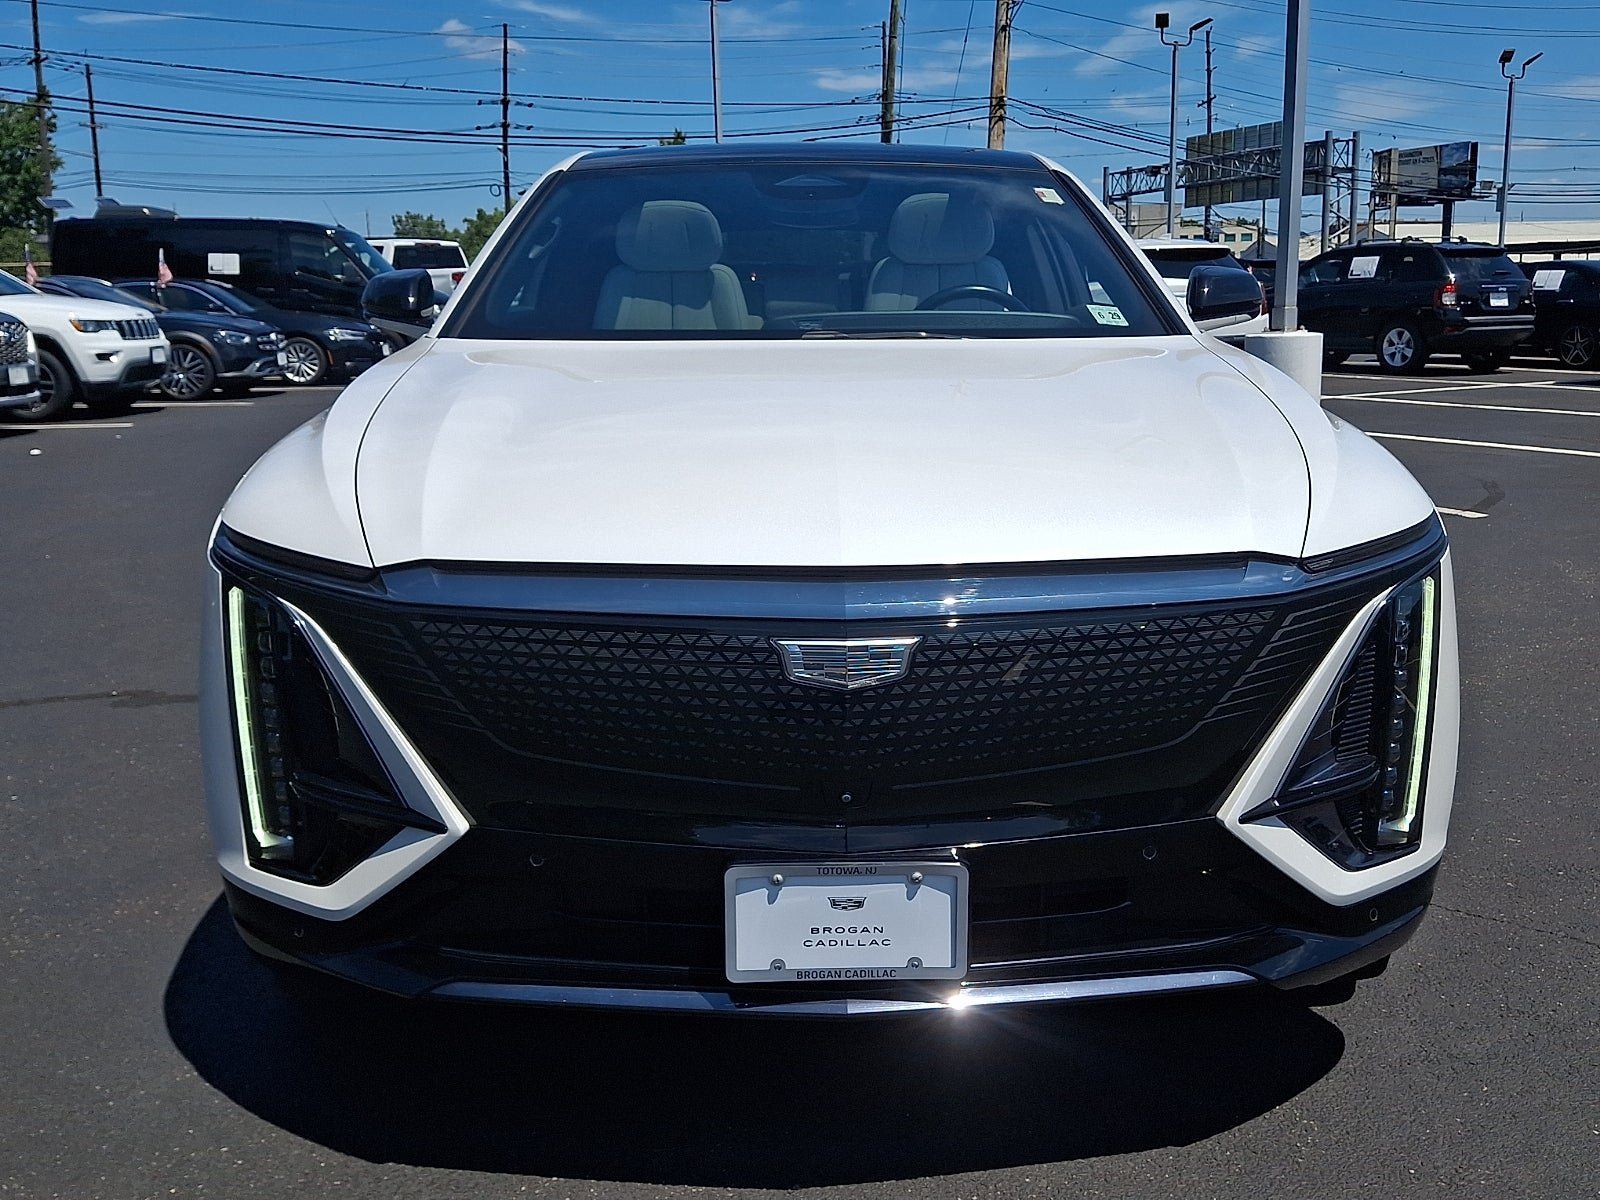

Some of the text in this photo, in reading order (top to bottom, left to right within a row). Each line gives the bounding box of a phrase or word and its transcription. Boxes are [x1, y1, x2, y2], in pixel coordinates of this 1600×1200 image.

[865, 866, 878, 875] NJ
[810, 926, 883, 934] BROGAN
[803, 939, 891, 947] CADILLAC
[796, 969, 896, 979] BROGAN CADILLAC
